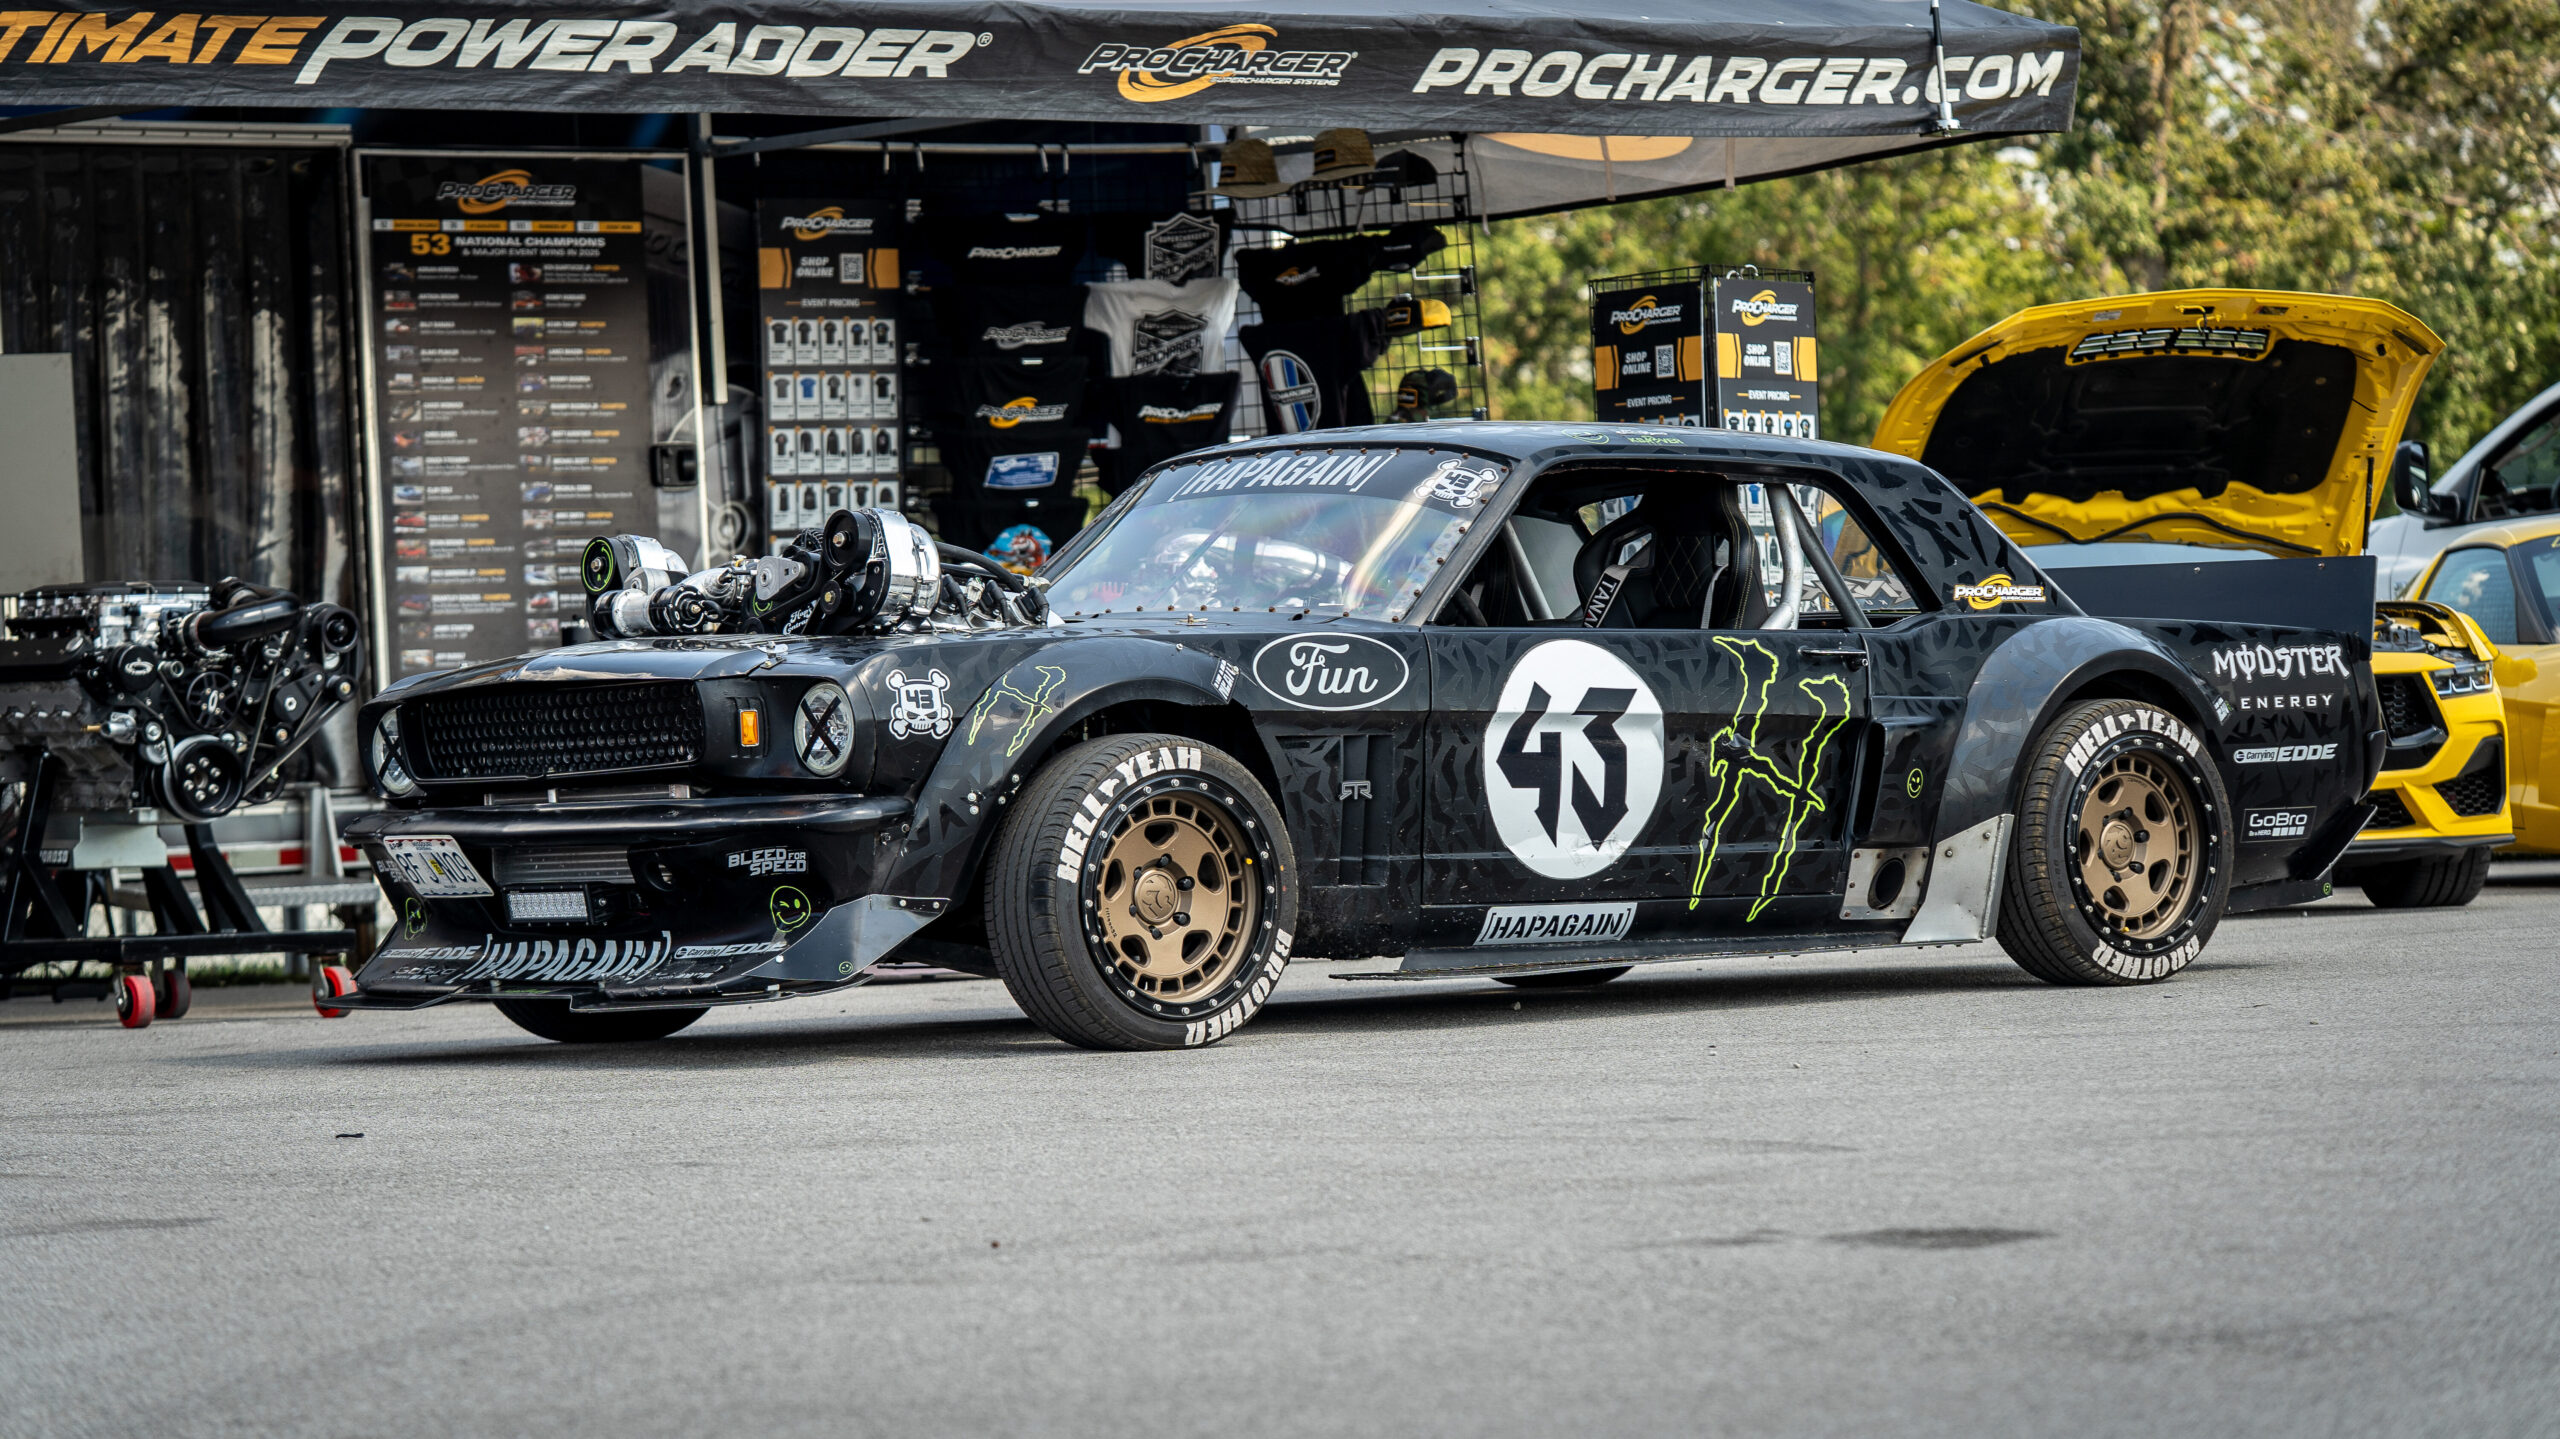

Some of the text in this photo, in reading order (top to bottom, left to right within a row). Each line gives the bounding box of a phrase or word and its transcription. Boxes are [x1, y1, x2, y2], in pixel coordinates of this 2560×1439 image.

[295, 17, 678, 84] POWER
[1209, 76, 1341, 86] SUPERCHARGER SYSTEMS
[1412, 47, 2065, 106] PROCHARGER.COM
[437, 182, 576, 200] PROCHARGER
[780, 217, 873, 230] PROCHARGER
[410, 233, 606, 256] 53 NATIONAL CHAMPIONS
[472, 248, 507, 256] MAJOR
[508, 248, 538, 256] EVENT
[540, 248, 565, 256] WINS
[566, 248, 577, 257] IN
[801, 256, 829, 266] SHOP
[967, 246, 1062, 260] PROCHARGER
[795, 267, 834, 277] ONLINE
[801, 298, 860, 308] EVENT PRICING
[1731, 299, 1799, 315] PROCHARGER
[1610, 304, 1681, 325] PROCHARGER
[1624, 351, 1648, 364] SHOP
[1745, 344, 1767, 355] SHOP
[1622, 361, 1651, 375] ONLINE
[1743, 354, 1771, 368] ONLINE
[1626, 394, 1672, 409] EVENT PRICING
[1748, 390, 1790, 402] EVENT PRICING
[1444, 469, 1473, 490] 43
[1954, 584, 2042, 599] PROCHARGER
[1286, 641, 1379, 696] Fun
[905, 689, 934, 710] 43
[2240, 694, 2333, 710] ENERGY
[2064, 708, 2201, 778] HELL YEAH
[2246, 743, 2338, 762] Carrying EDDE
[1496, 681, 1638, 852] 43
[1057, 746, 1202, 884] HELL YEAH
[2249, 812, 2308, 827] GoBro
[728, 848, 806, 868] BLEED FOR
[749, 859, 807, 877] SPEED
[418, 945, 482, 960] EDDE
[2091, 934, 2200, 980] BROTHER
[1184, 928, 1293, 1046] BROTHER
